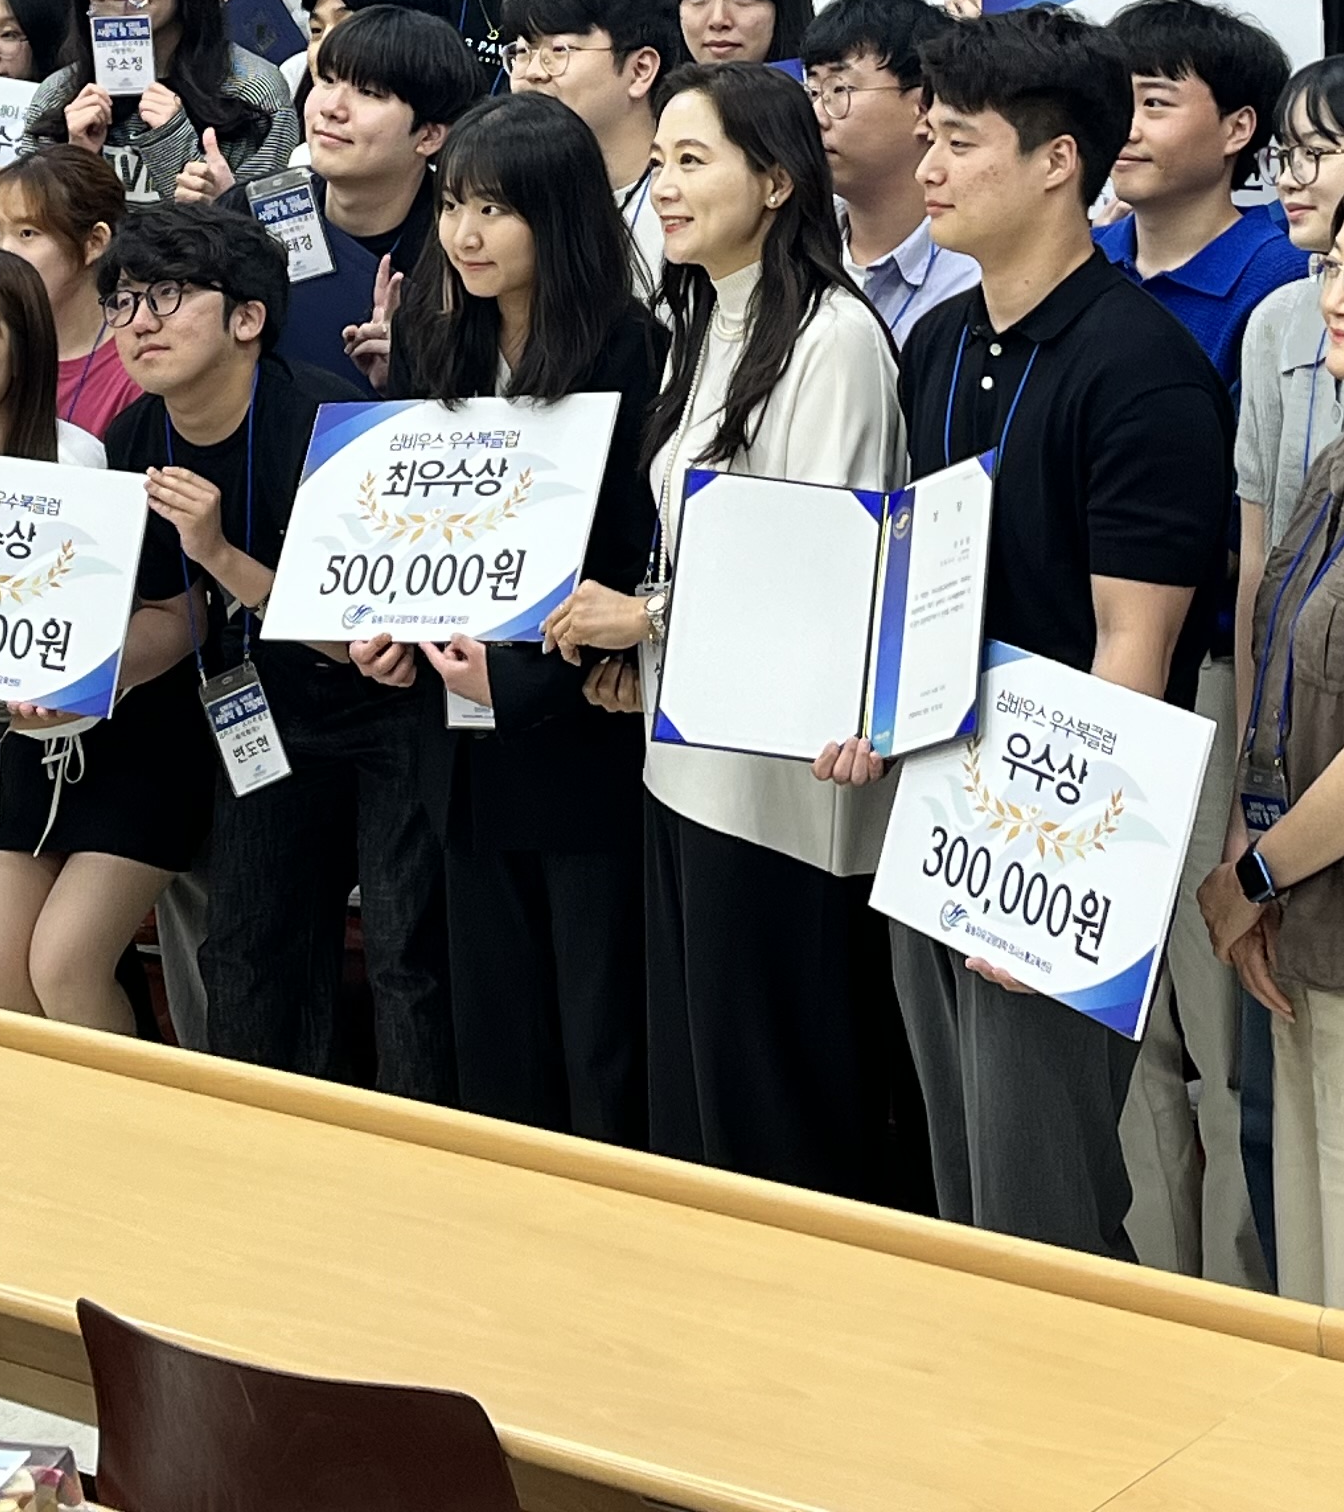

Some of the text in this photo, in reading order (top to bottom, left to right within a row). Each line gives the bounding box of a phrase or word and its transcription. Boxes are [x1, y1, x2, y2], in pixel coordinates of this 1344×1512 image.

[389, 429, 521, 452] 심비우스 우수북클럽
[381, 457, 509, 498] 최우수상
[319, 548, 526, 605] 500,000원
[995, 688, 1047, 728] 심비우스
[1049, 710, 1118, 756] 우수북클럽
[1001, 732, 1089, 806] 우수상
[922, 825, 1112, 965] 300,000원
